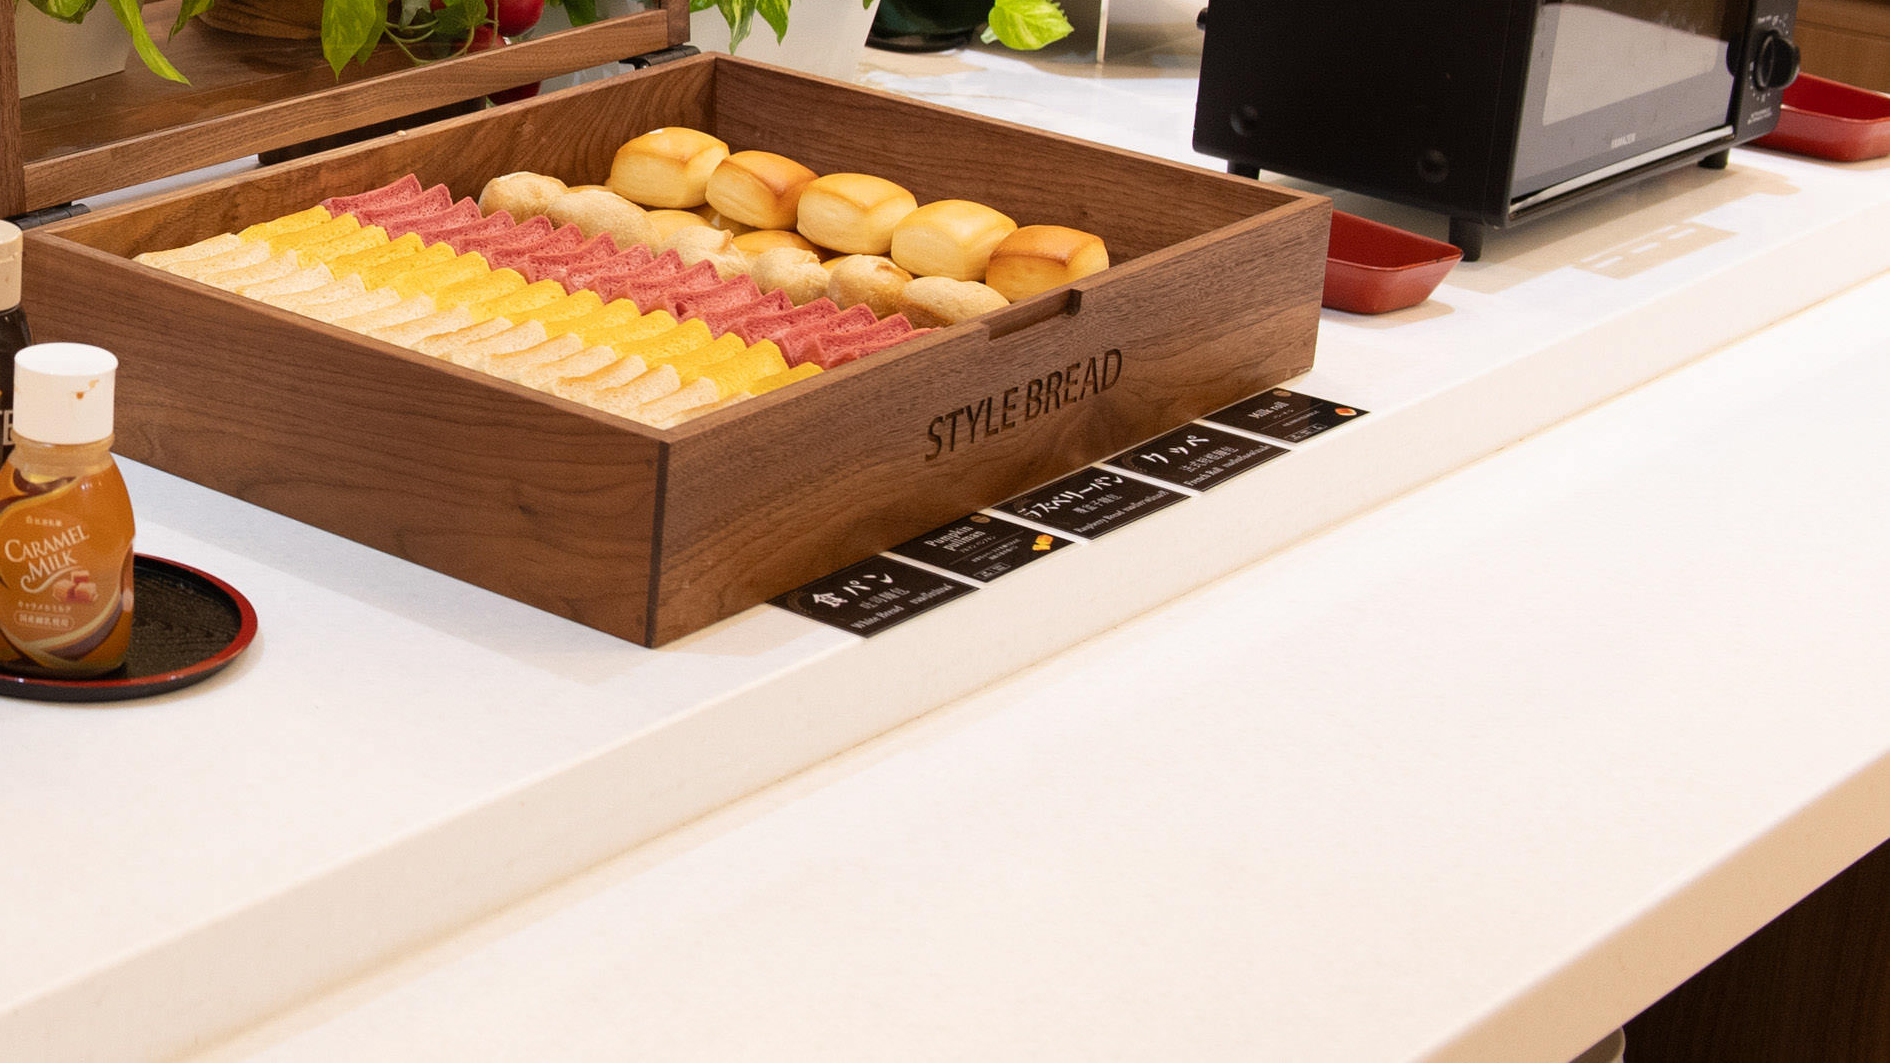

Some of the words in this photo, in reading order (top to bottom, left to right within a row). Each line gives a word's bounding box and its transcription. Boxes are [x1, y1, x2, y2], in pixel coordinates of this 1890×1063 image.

[925, 386, 1019, 463] STYLE
[1025, 348, 1123, 422] BREAD
[1140, 434, 1210, 465] クッペ
[1017, 475, 1124, 519] ラズベリーパン
[4, 525, 90, 563] CARAMEL
[924, 525, 974, 547] Pumpkin
[28, 549, 77, 581] MILK
[812, 573, 894, 608] 食パン
